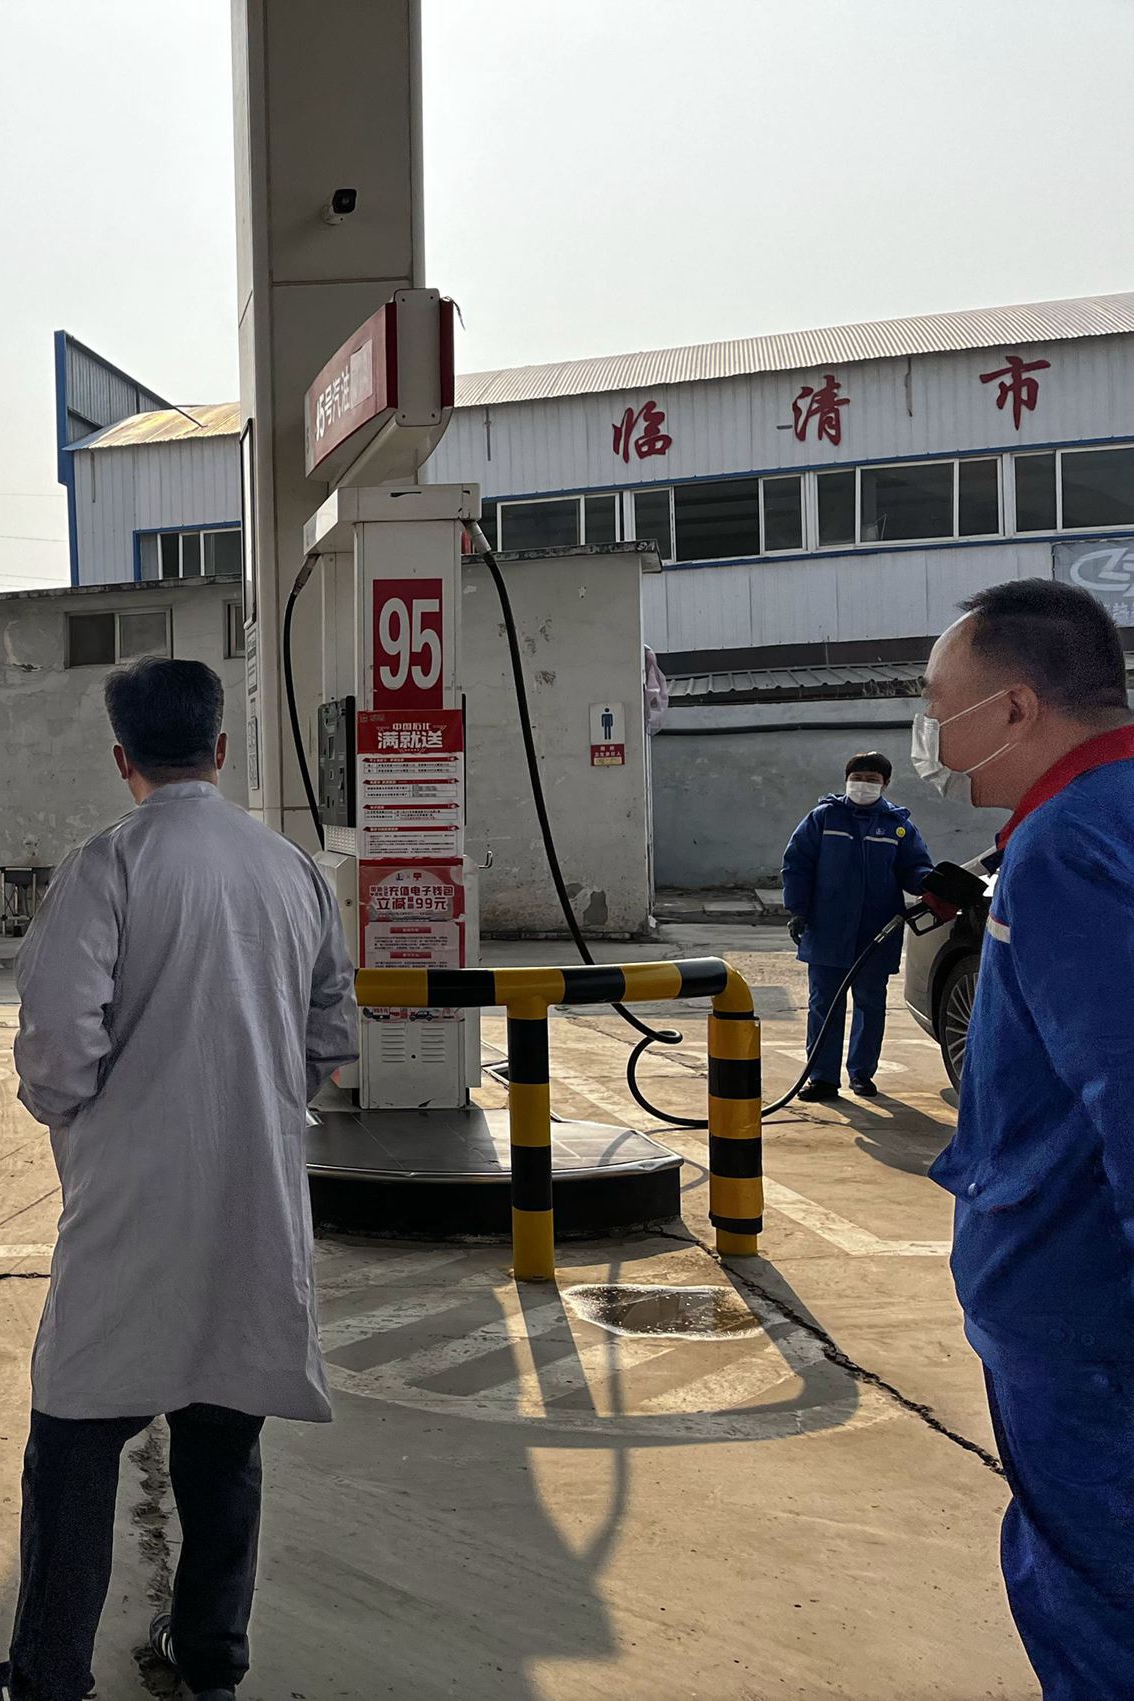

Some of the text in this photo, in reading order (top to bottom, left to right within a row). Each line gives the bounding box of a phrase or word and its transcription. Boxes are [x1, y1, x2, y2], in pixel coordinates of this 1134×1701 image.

[612, 355, 1052, 463] 临清市
[378, 597, 442, 690] 95
[377, 730, 443, 749] 满就送
[389, 886, 454, 897] 充值电子钱包
